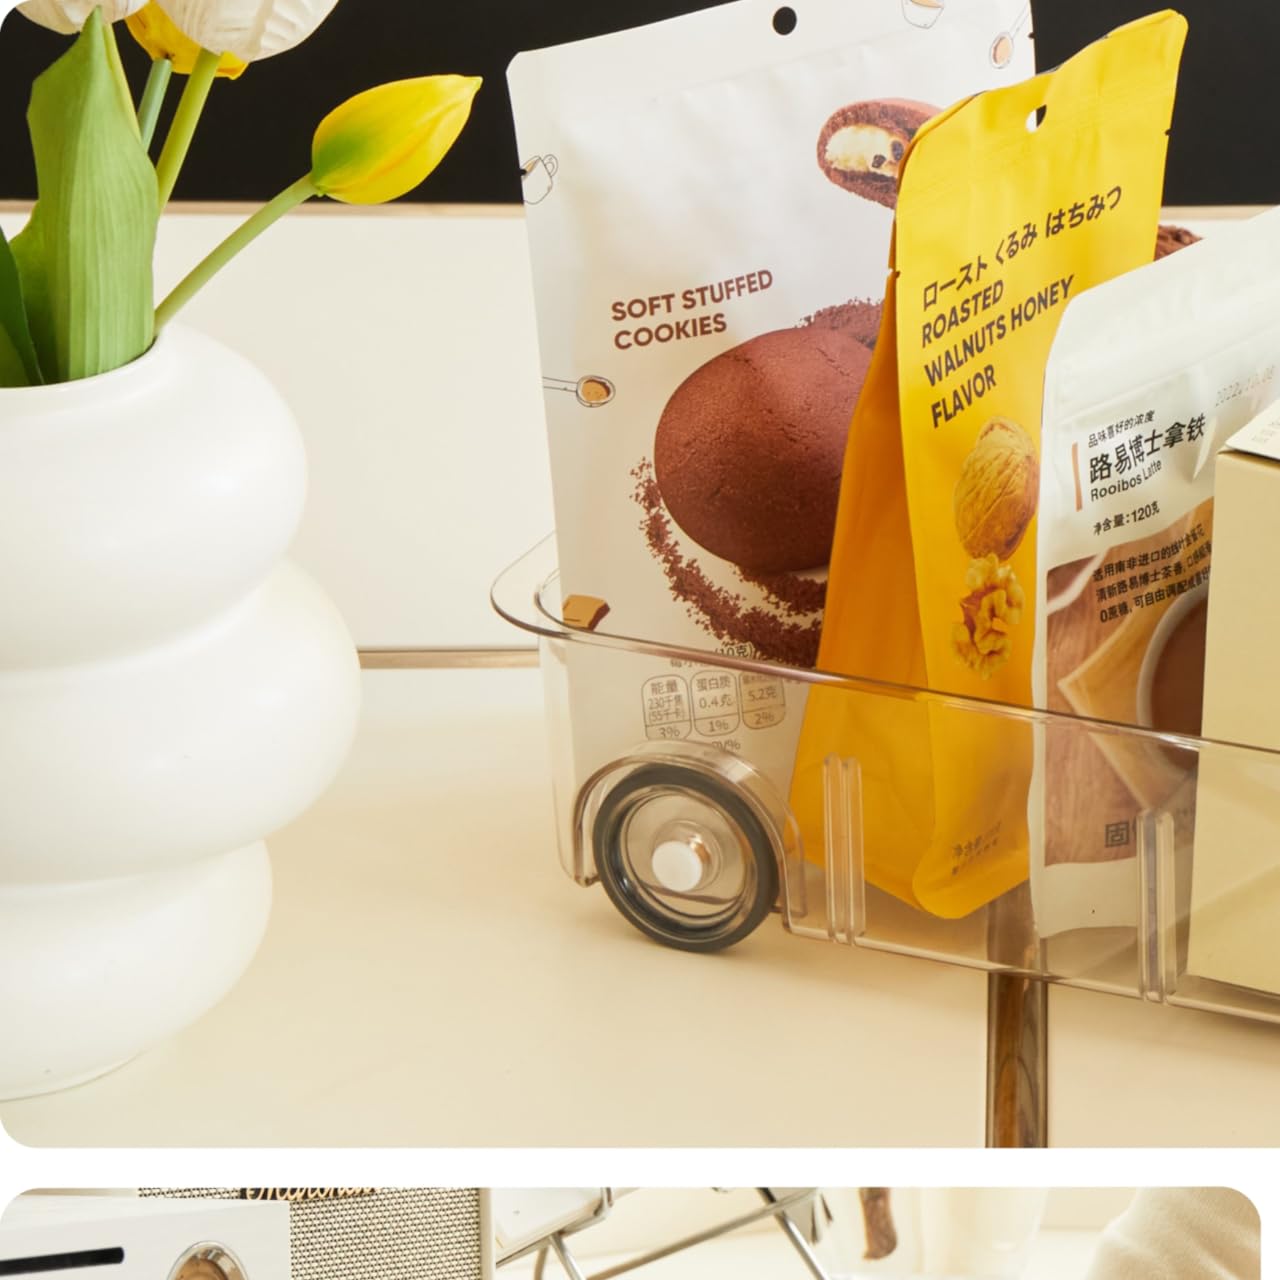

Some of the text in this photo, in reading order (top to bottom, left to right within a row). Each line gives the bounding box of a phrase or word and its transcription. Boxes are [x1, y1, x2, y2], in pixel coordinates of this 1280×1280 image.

[923, 185, 1122, 311] ロースト くるみ はちみつ
[611, 269, 773, 321] SOFT STUFFED
[922, 279, 1004, 348] ROASTED
[614, 313, 727, 350] COOKIES
[924, 274, 1074, 388] WALNUTS HONEY
[931, 364, 997, 428] FLAVOR
[1088, 410, 1155, 448] 品味喜好的浓度
[1089, 413, 1206, 484] 路易博士拿铁
[1091, 458, 1162, 502] Rooibos Latte
